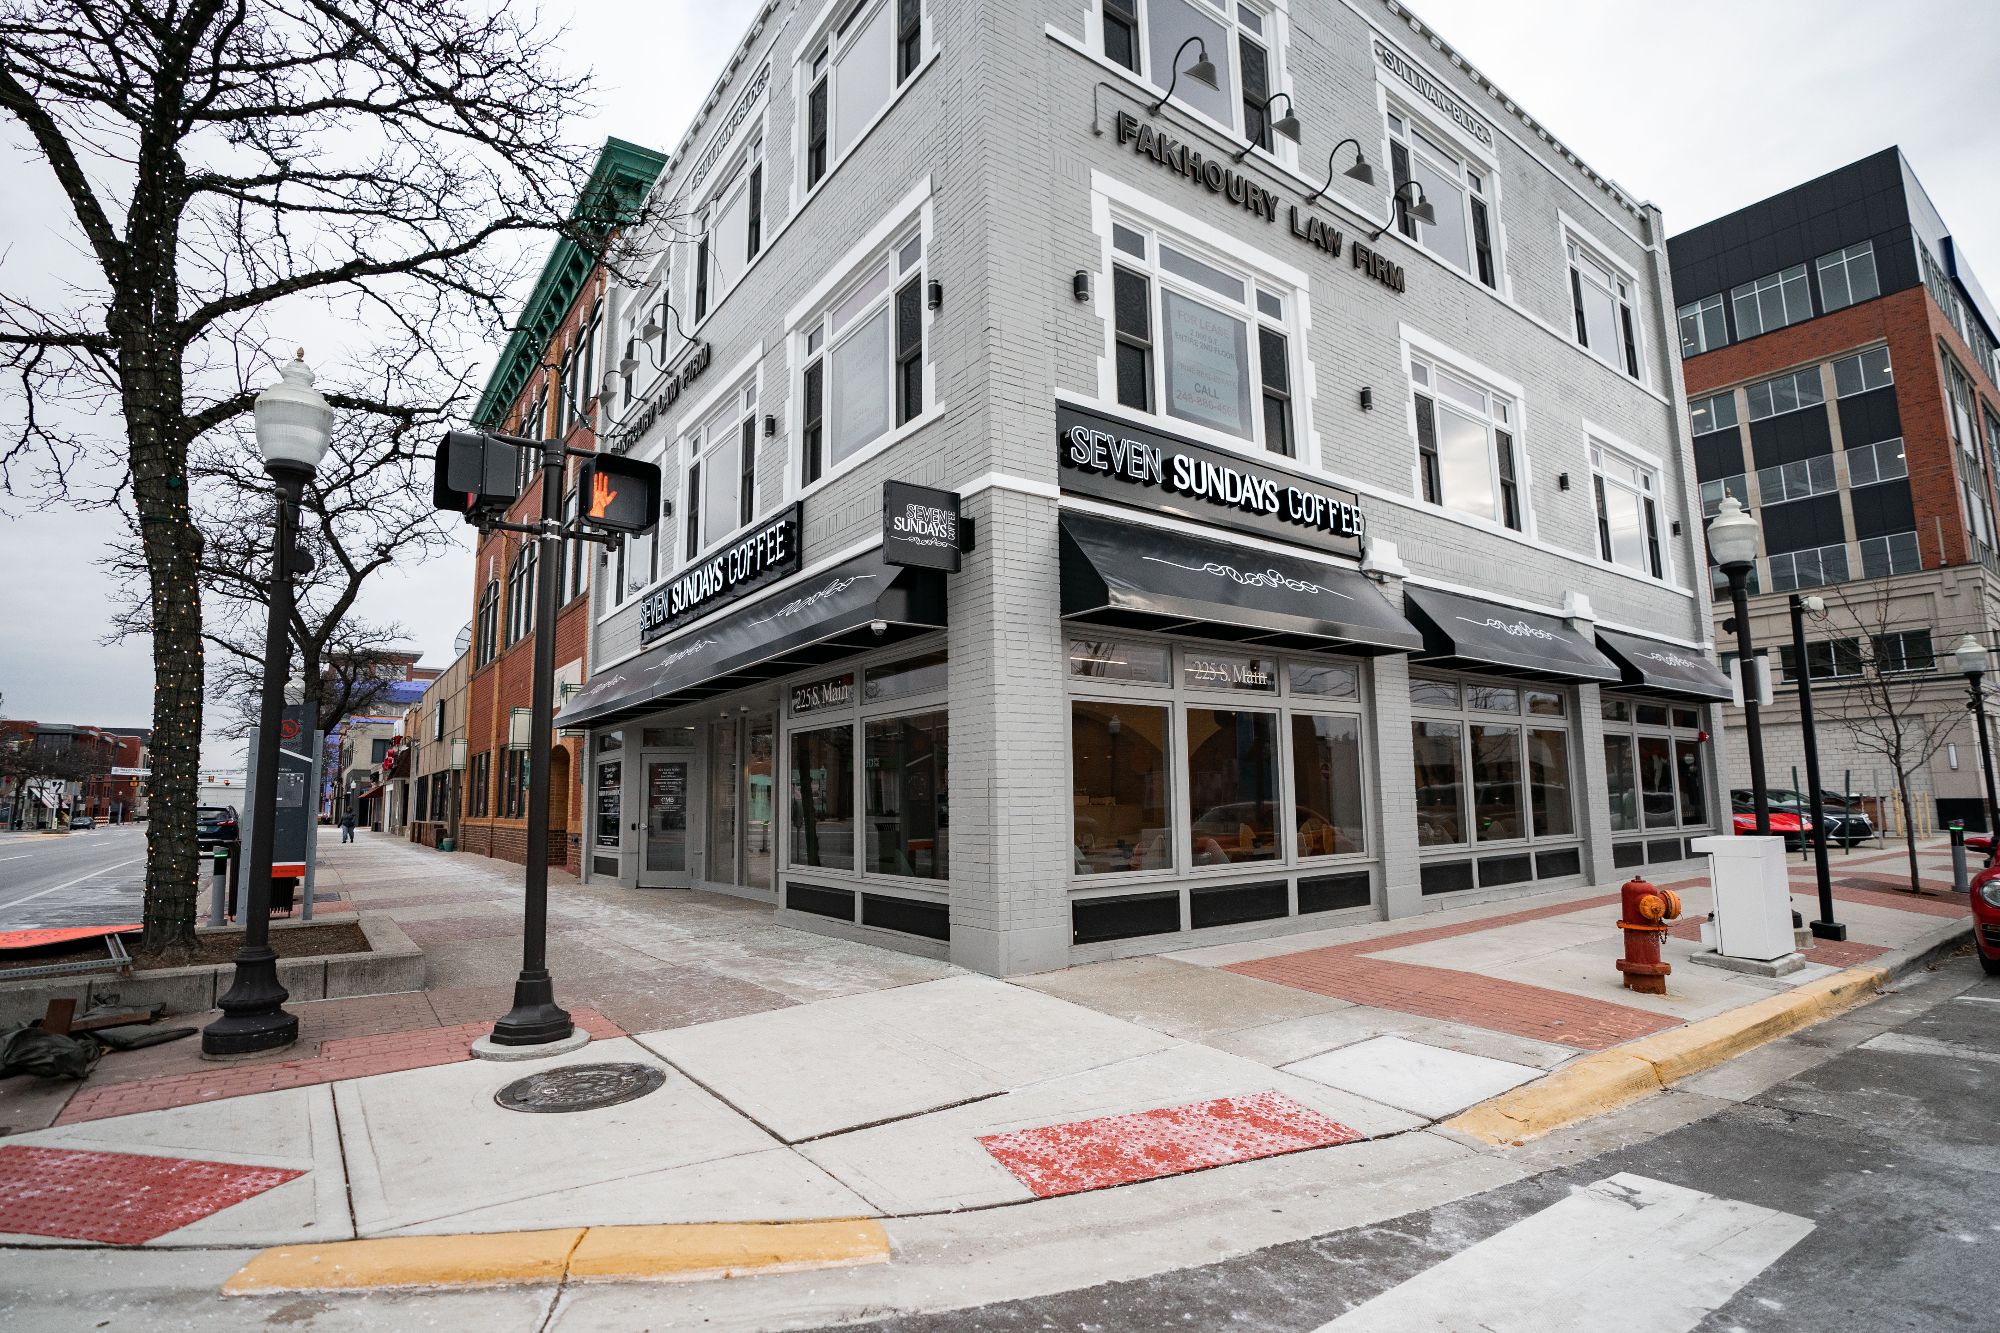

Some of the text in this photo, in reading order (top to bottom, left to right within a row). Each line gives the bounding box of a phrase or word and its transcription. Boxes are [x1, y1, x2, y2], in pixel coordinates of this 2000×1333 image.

[1384, 50, 1446, 112] SULLIVAN
[1117, 110, 1406, 294] FAKHOURY LAW FIRM
[682, 342, 711, 391] FIRM
[1194, 383, 1221, 399] CALL
[1069, 425, 1364, 536] SEVEN SUNDAYS COFFEE
[894, 516, 947, 537] SUNDAYS
[906, 503, 947, 525] SEVEN
[948, 511, 956, 541] COFFEE
[640, 520, 786, 631] SEVEN SUNDAYS COFFEE
[1194, 660, 1267, 685] 225 S. Main
[796, 688, 811, 708] 225
[821, 680, 849, 703] Main
